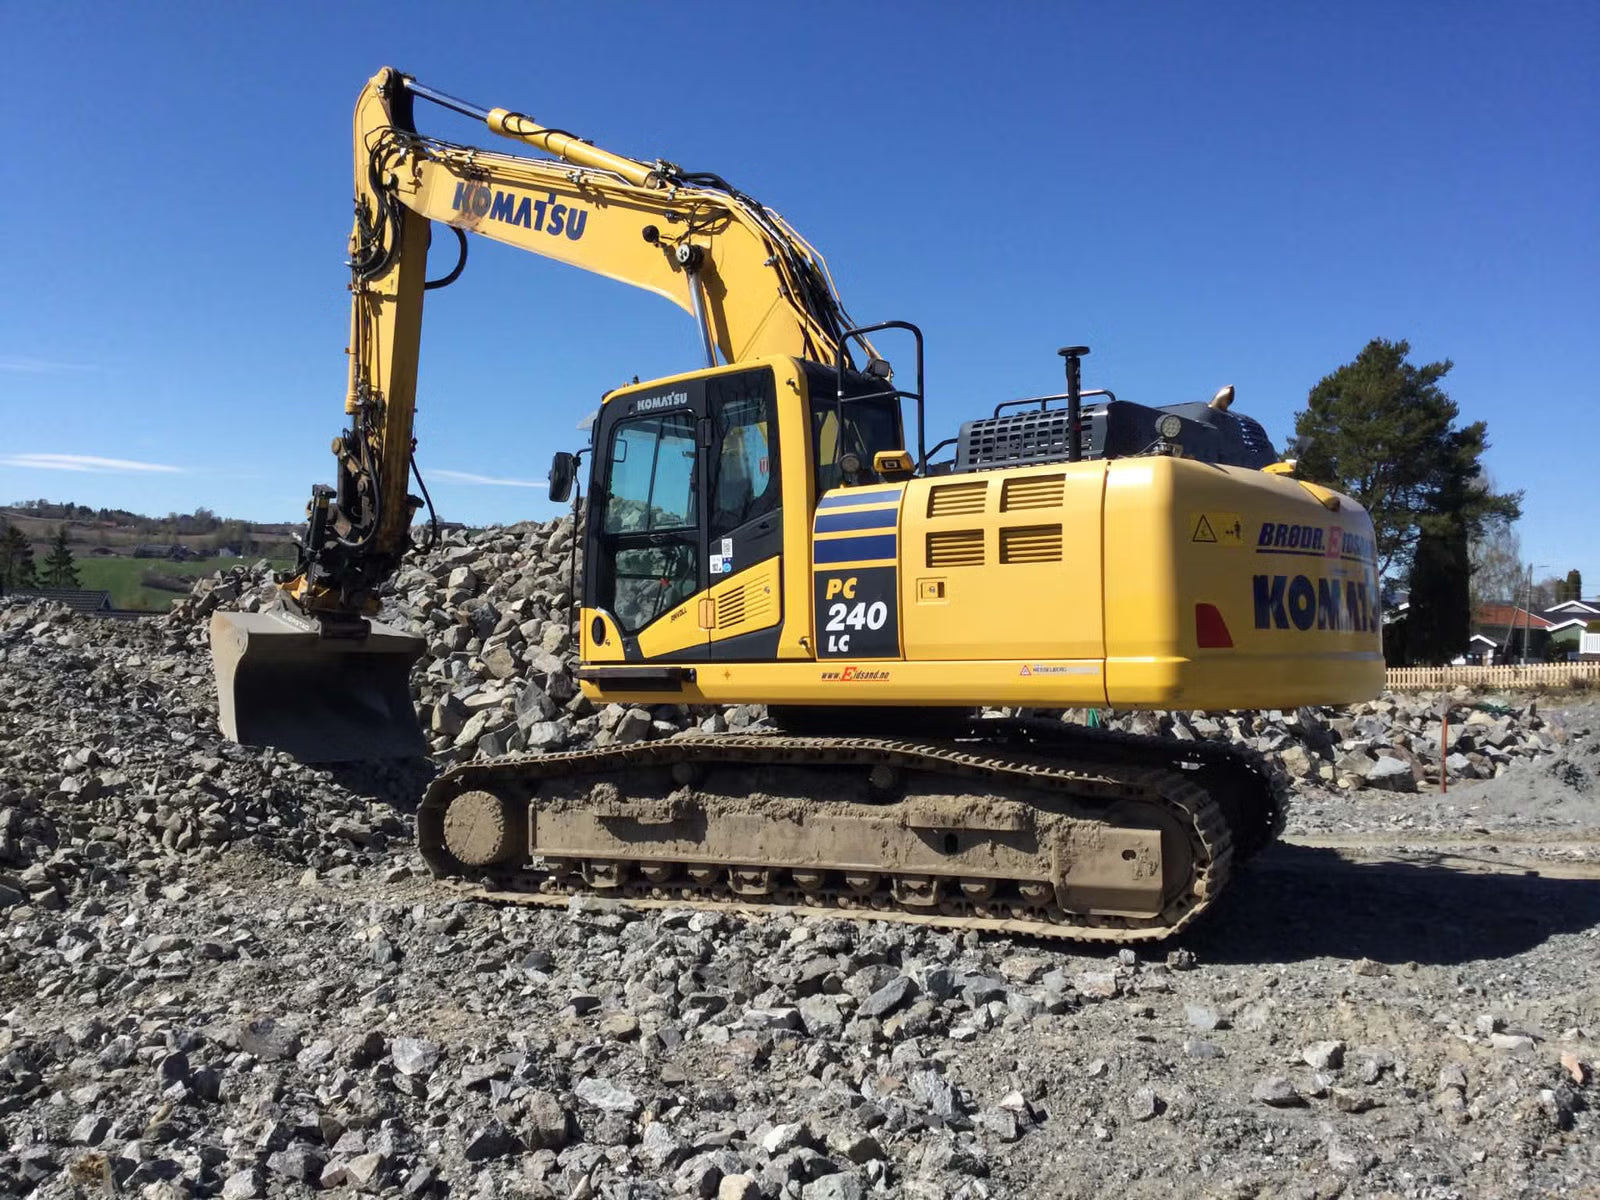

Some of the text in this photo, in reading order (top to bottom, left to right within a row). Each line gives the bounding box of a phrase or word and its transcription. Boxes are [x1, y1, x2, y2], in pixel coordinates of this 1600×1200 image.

[452, 181, 588, 241] KOMATSU
[637, 391, 688, 411] KOMATSU
[825, 577, 858, 600] PC
[825, 601, 888, 631] 240
[828, 634, 850, 652] LC
[821, 666, 890, 681] www.Eidsand.no
